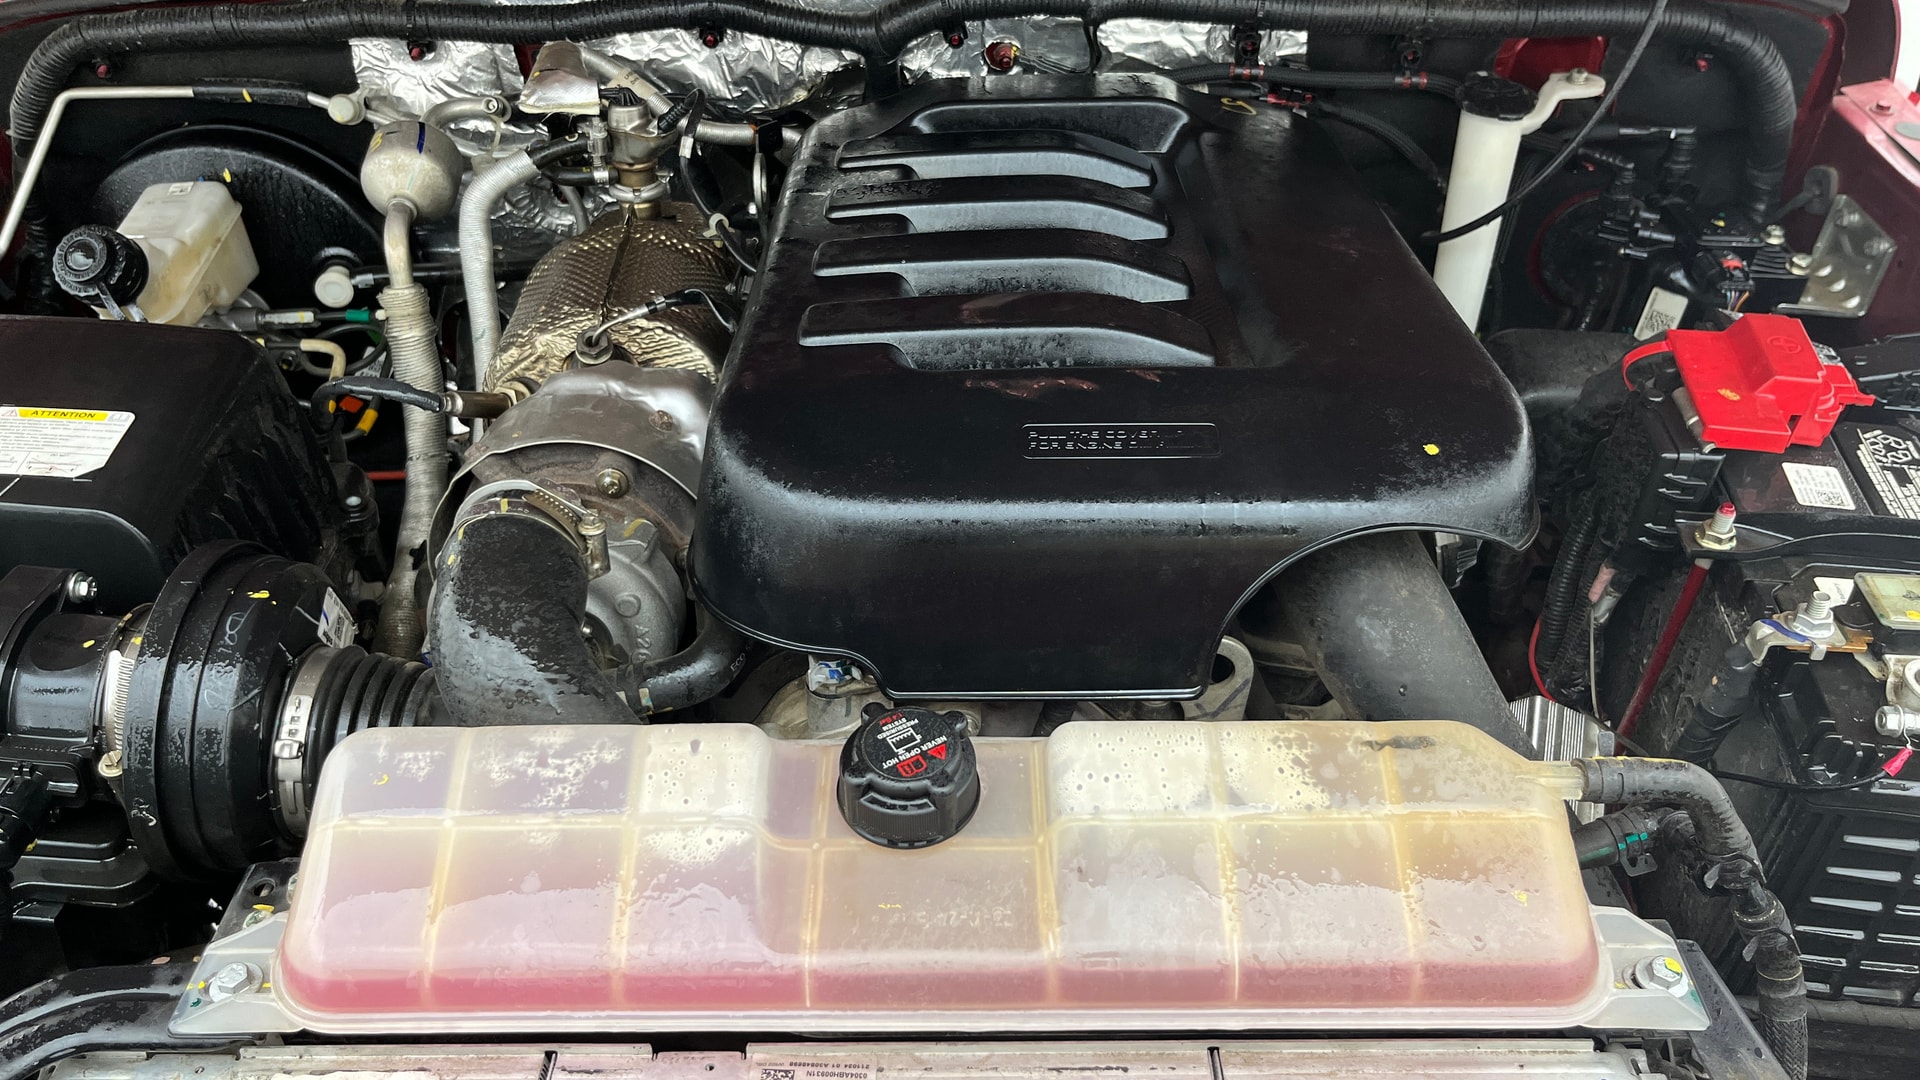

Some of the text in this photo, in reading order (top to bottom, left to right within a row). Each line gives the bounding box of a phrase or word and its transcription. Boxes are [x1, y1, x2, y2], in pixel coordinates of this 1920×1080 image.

[30, 409, 97, 419] ATTENTION
[877, 718, 919, 740] PRESSURISED
[882, 717, 907, 731] SYSTEM
[882, 735, 948, 769] NEVER OPEN HOT
